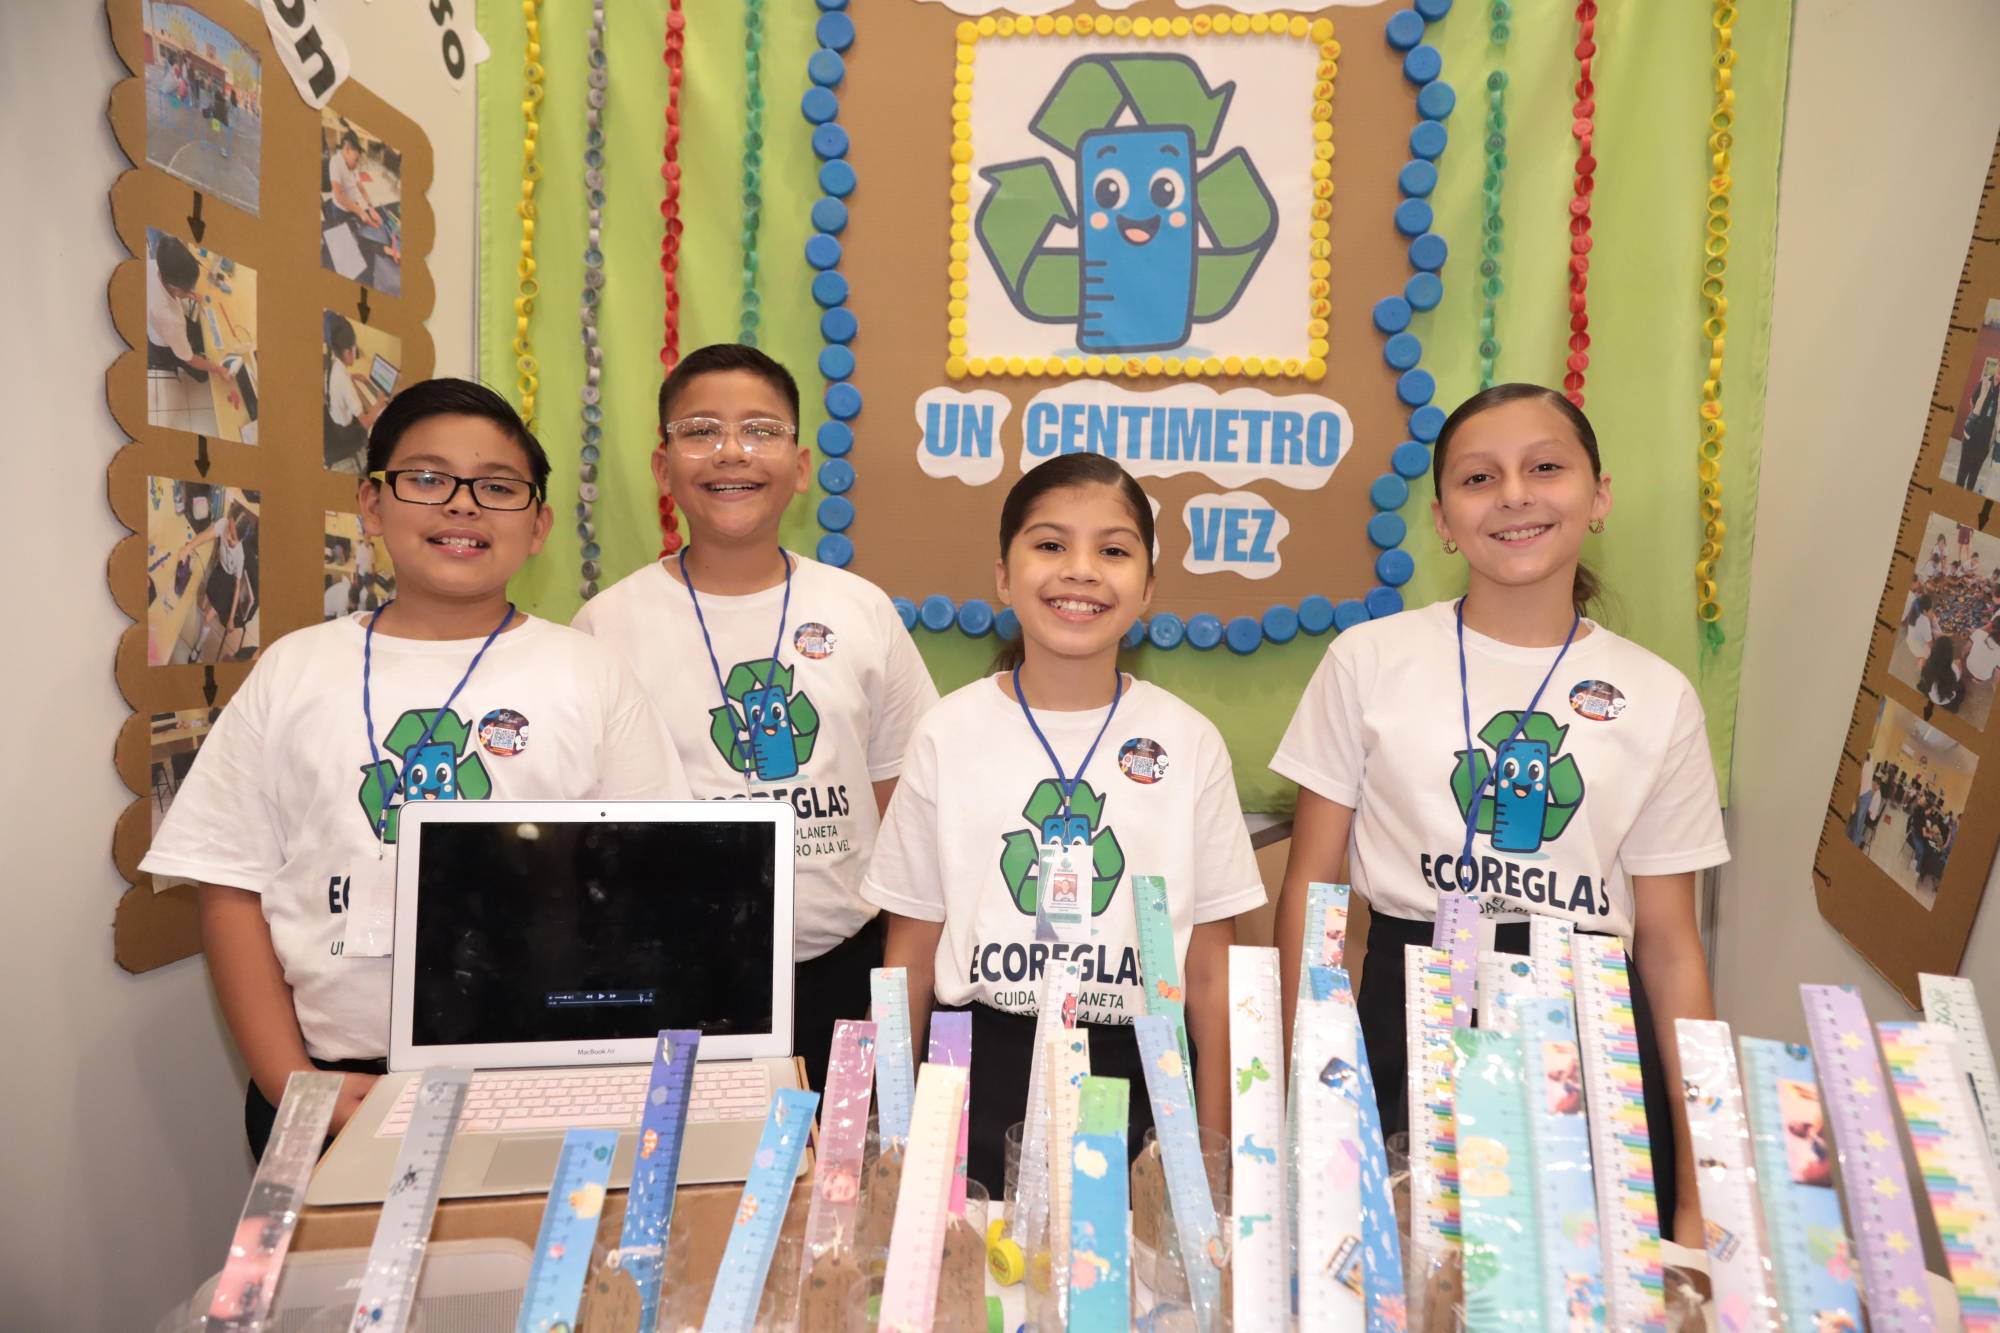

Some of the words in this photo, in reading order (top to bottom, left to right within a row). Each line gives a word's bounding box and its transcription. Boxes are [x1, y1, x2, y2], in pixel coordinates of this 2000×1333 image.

[925, 402, 994, 458] UN
[1026, 401, 1341, 468] CENTIMETRO
[1189, 506, 1275, 563] VEZ
[796, 825, 838, 839] LANETA
[1421, 853, 1610, 916] ECOREGLAS
[970, 942, 1143, 986] ECORGLA
[994, 990, 1036, 1007] CUIDA
[1078, 991, 1124, 1008] ANETA
